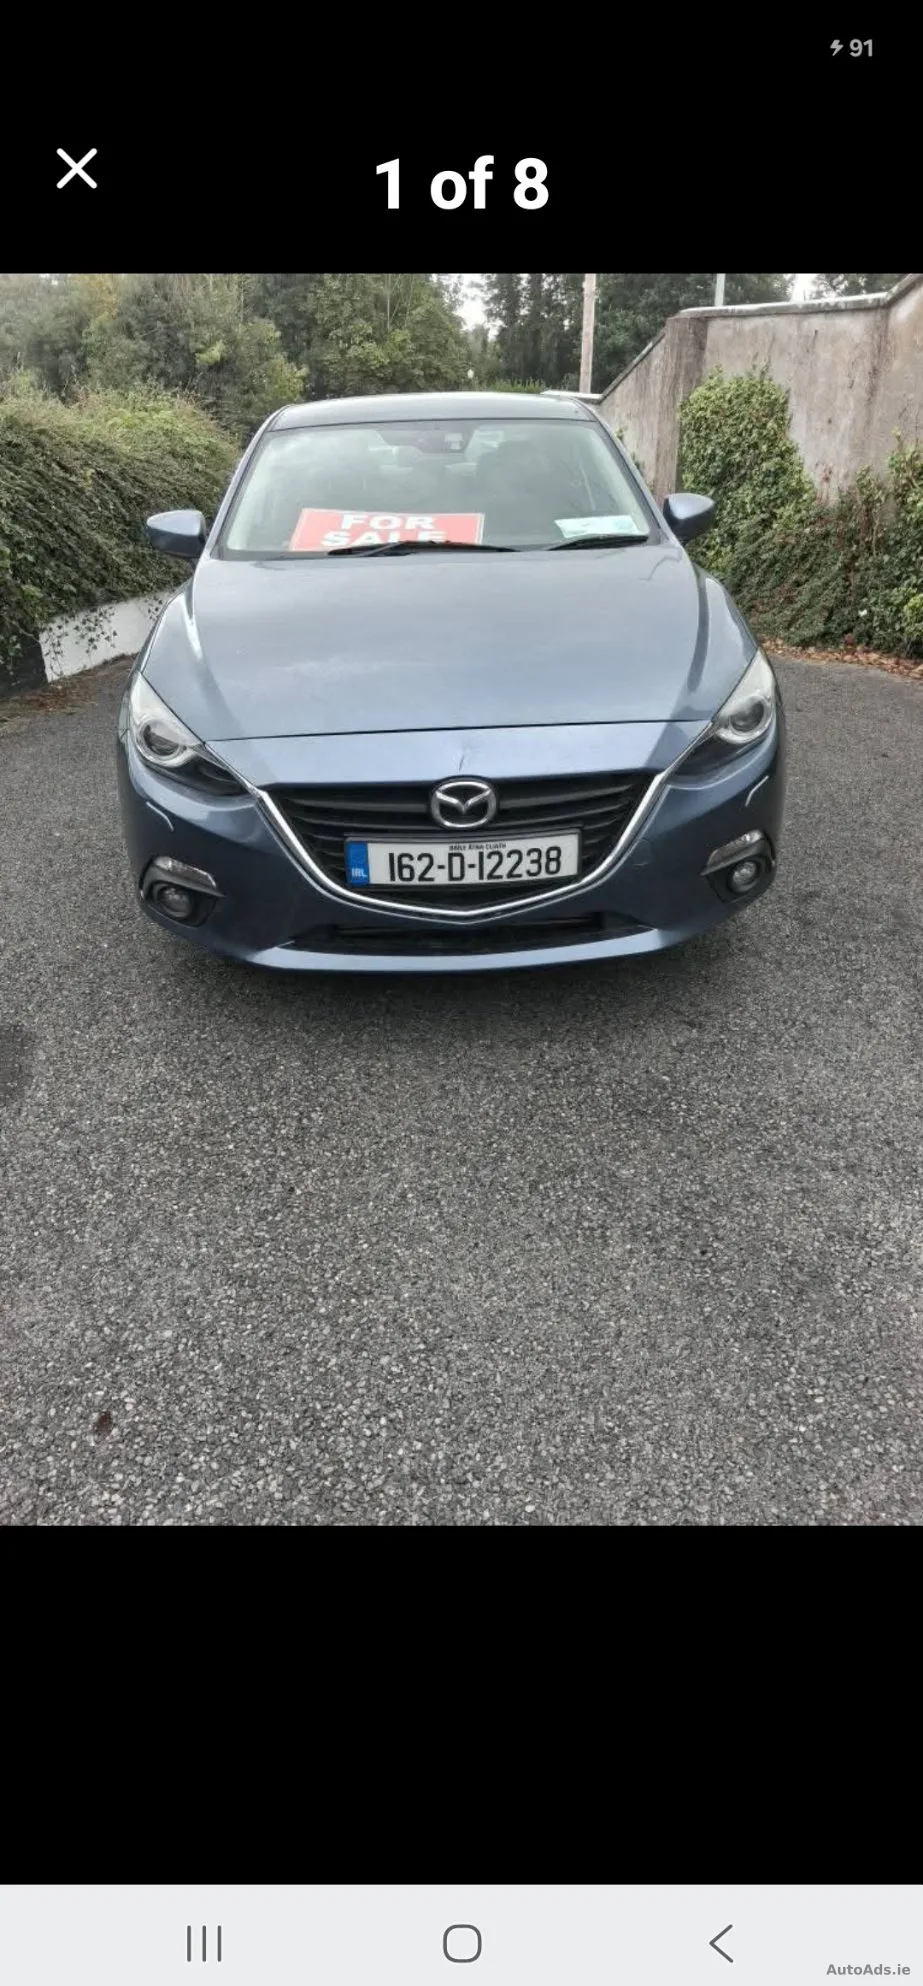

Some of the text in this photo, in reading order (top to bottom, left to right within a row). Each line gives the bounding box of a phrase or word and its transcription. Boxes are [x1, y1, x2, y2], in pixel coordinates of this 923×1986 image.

[341, 513, 434, 530] FOR
[351, 868, 368, 877] IRL
[389, 846, 562, 882] 162-D-12238
